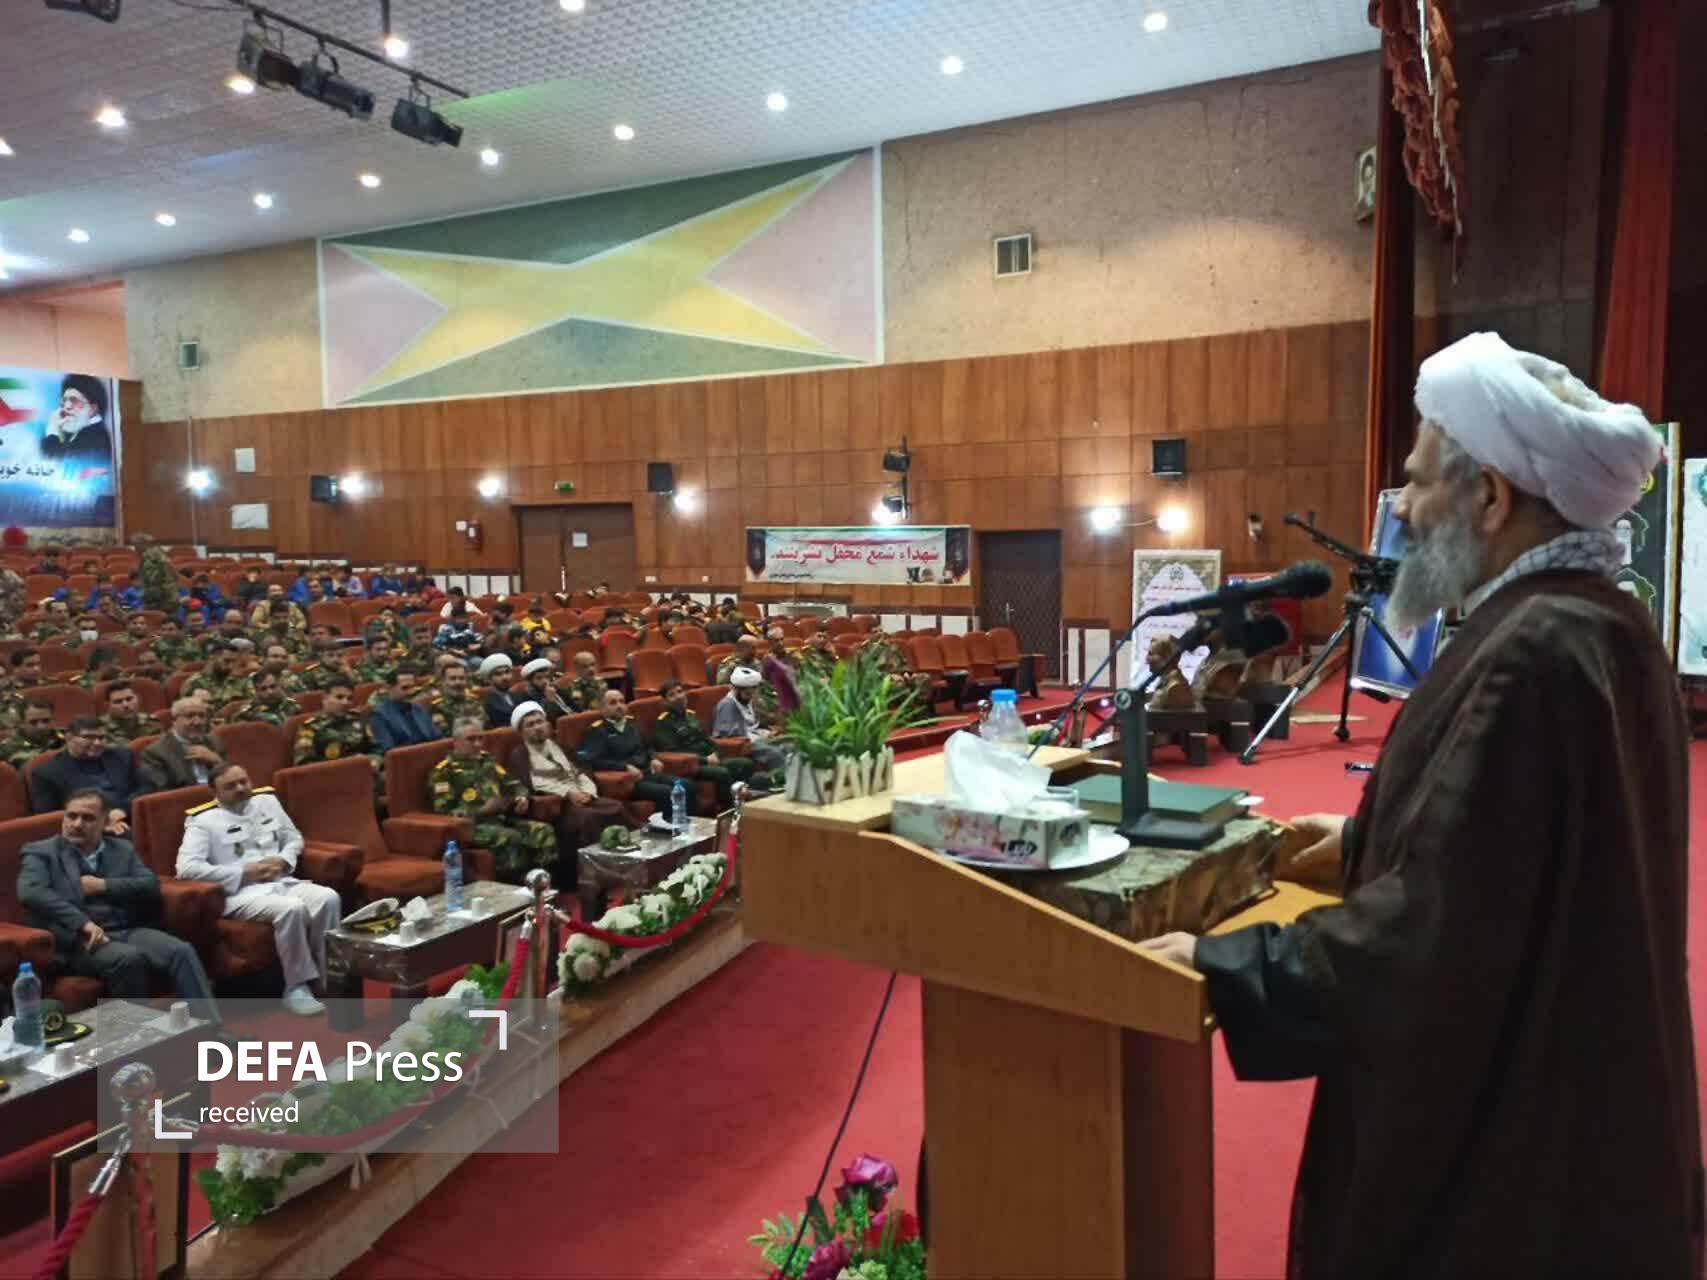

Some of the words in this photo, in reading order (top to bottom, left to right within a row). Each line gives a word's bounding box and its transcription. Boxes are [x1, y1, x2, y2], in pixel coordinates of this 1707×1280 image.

[825, 544, 863, 564] محفل
[866, 547, 896, 565] شمع
[899, 545, 939, 563] شهداء
